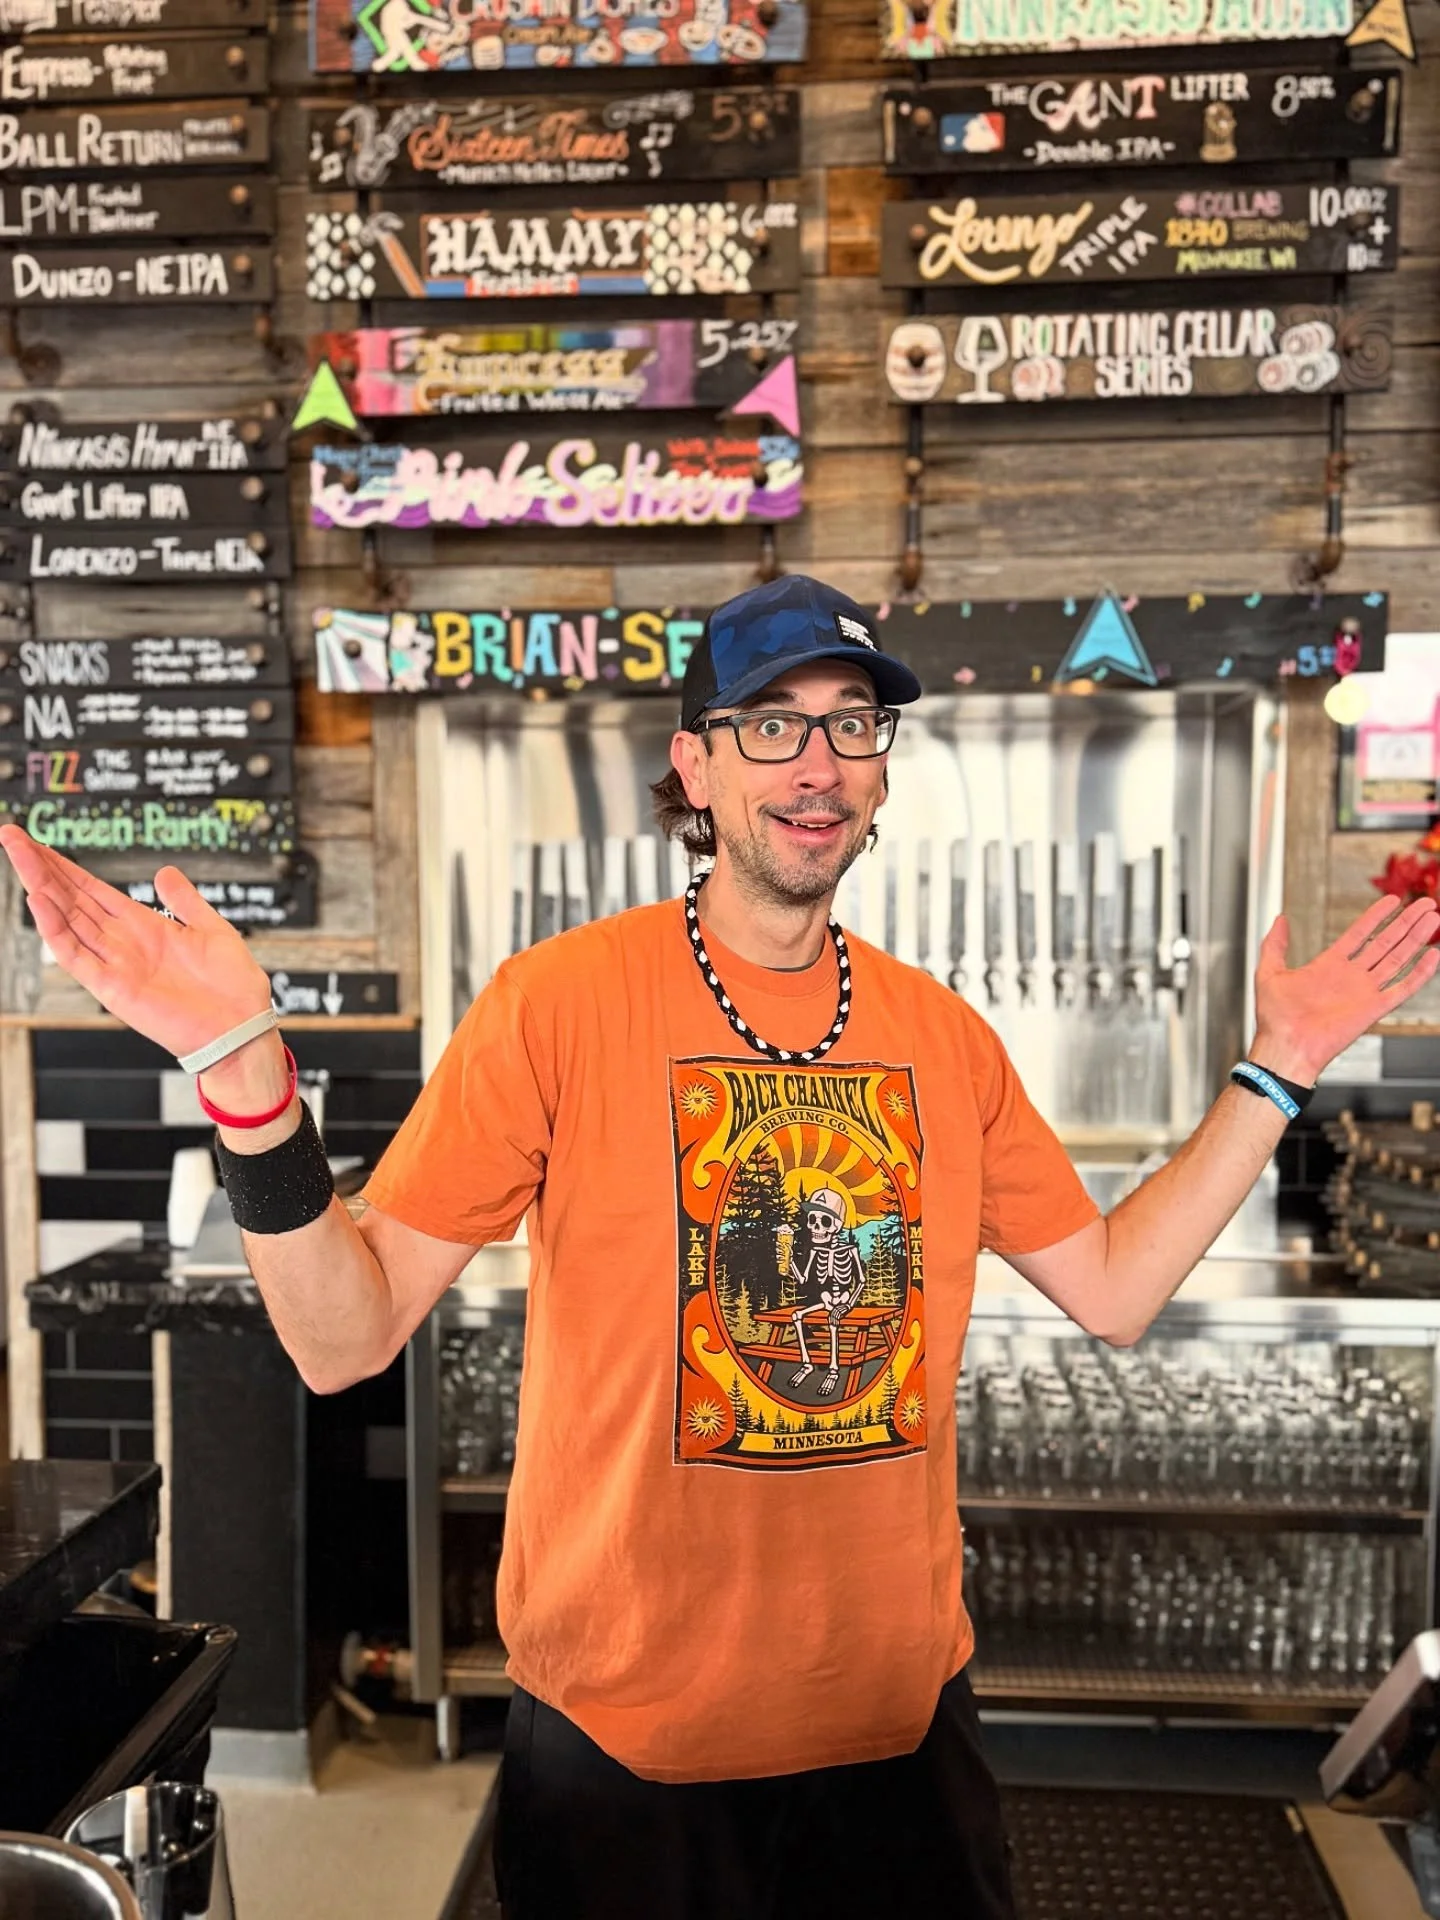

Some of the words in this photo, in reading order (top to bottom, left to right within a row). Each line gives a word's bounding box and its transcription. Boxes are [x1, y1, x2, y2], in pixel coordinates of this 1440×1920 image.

[1170, 72, 1250, 101] LIFTER
[0, 114, 75, 169] BALL
[78, 114, 184, 166] RETURN
[427, 217, 644, 277] HAMMY
[1058, 195, 1148, 276] TRIPLE
[1106, 229, 1158, 274] IPA
[12, 254, 113, 299] DUNZO
[1010, 311, 1170, 361] ROTATING
[1174, 308, 1276, 358] CELLAR
[1094, 354, 1193, 399] SERIES
[19, 640, 110, 686] SNACKS
[23, 695, 75, 740] NA
[26, 751, 83, 793] FIZZ
[27, 801, 134, 848] Green
[143, 801, 229, 847] Party
[723, 1072, 783, 1155] BACK
[783, 1072, 892, 1151] CHANNEL
[1259, 1075, 1291, 1109] TACKLE
[759, 1111, 824, 1133] BREWING
[829, 1118, 849, 1134] CO.
[688, 1227, 706, 1286] LAKE
[773, 1431, 864, 1450] MINNESOTA
